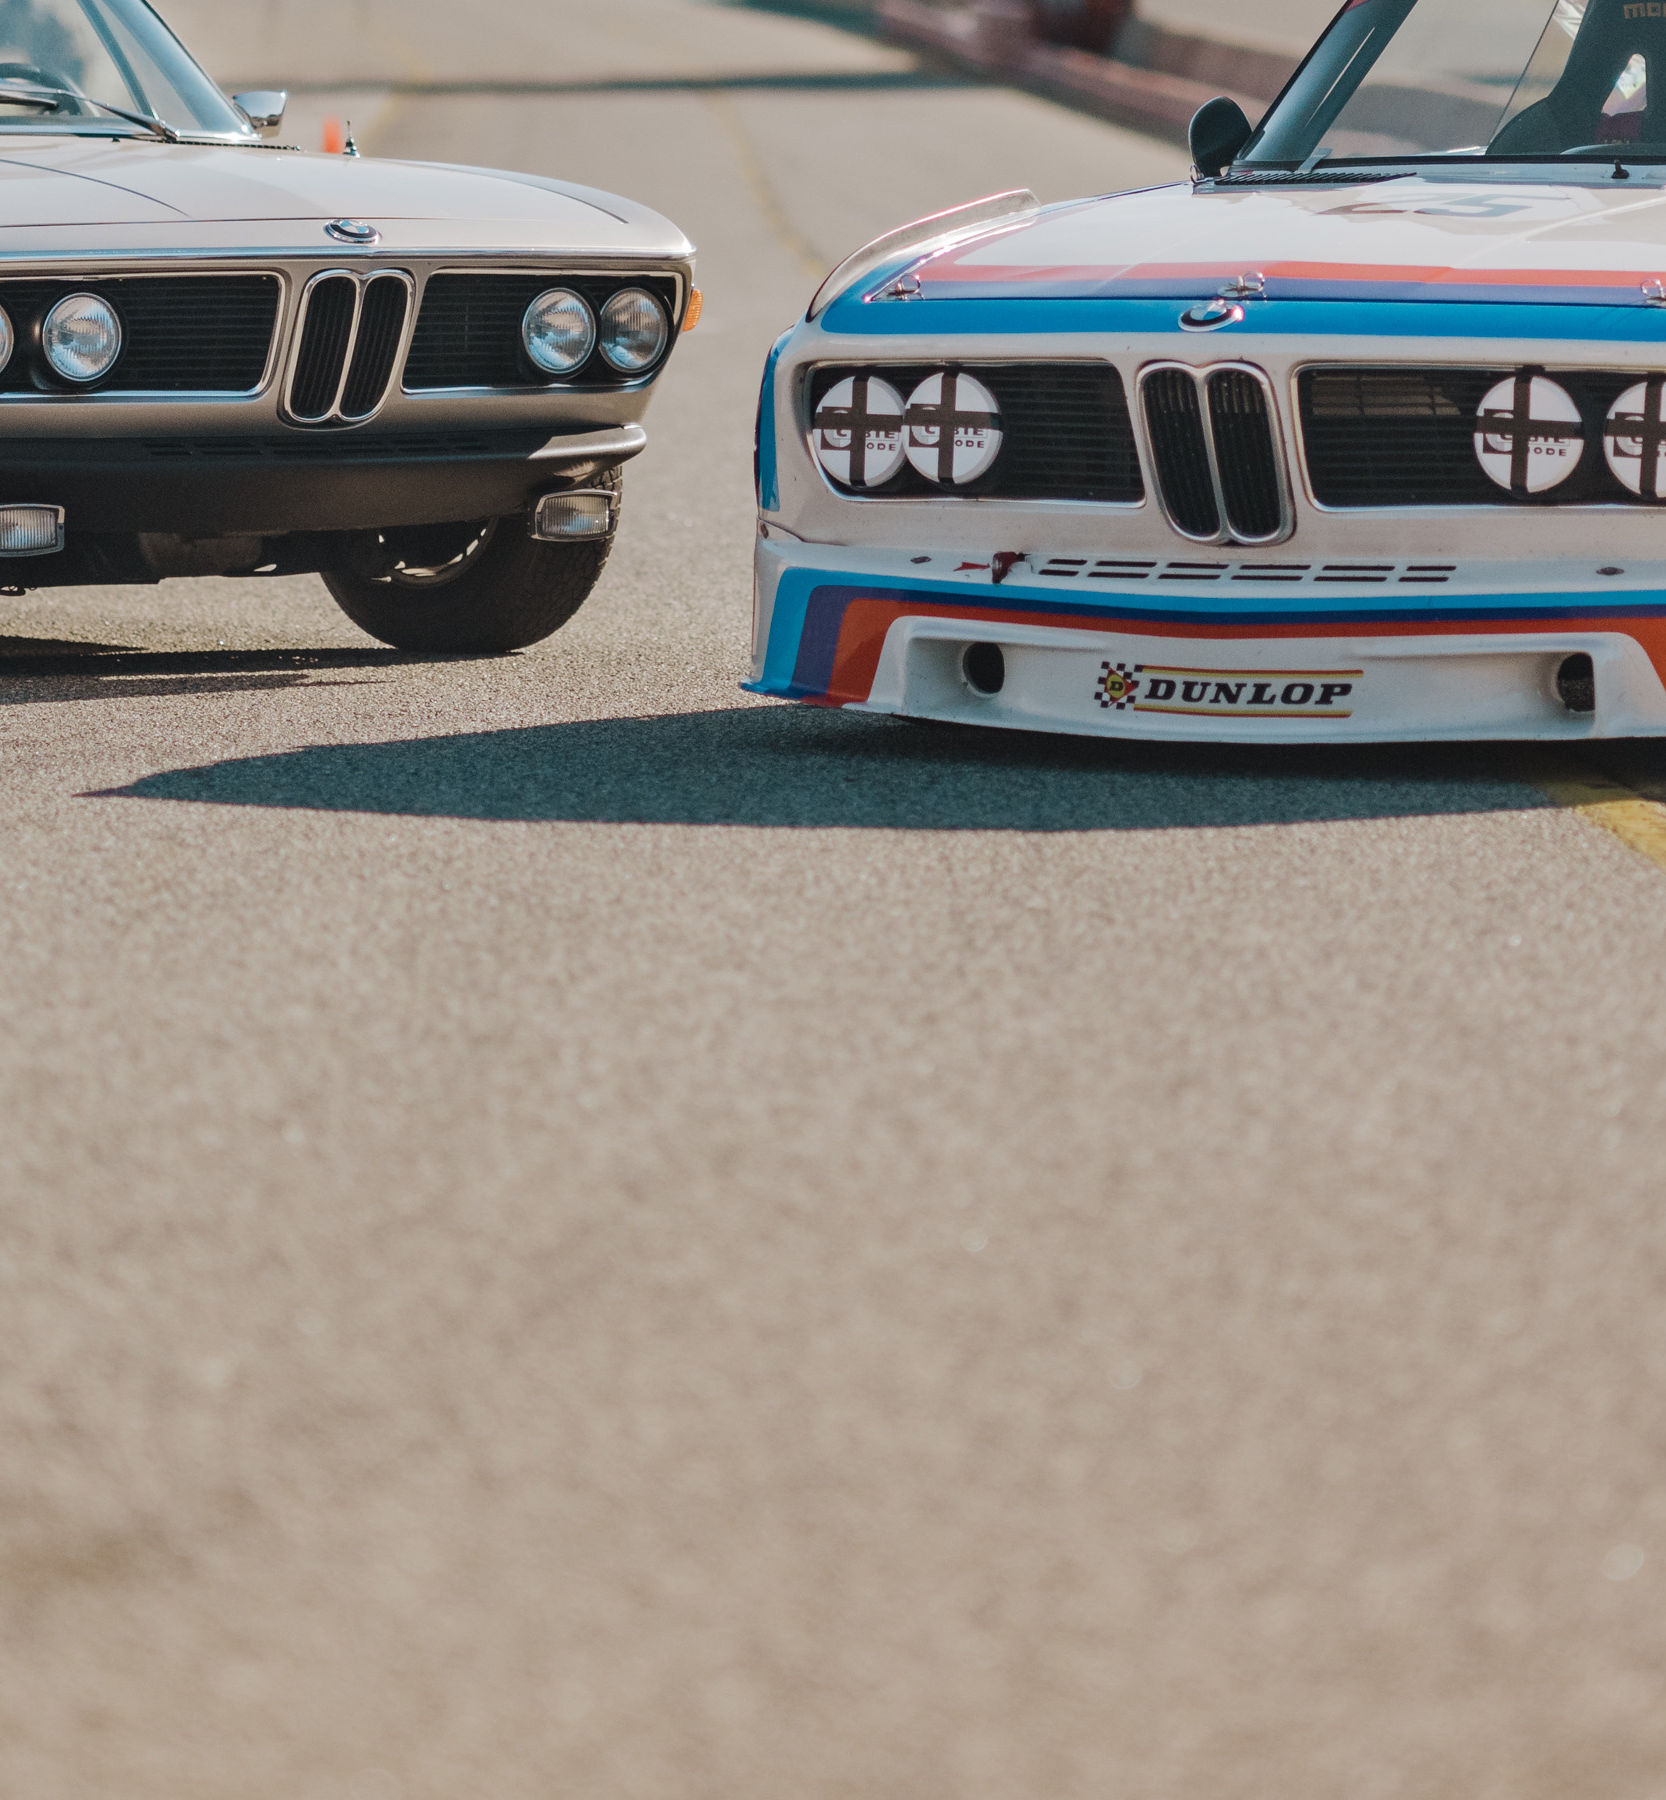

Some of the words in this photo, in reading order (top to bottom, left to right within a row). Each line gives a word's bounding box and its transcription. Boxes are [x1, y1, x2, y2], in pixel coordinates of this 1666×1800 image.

[866, 442, 897, 452] ODE
[954, 439, 985, 449] ODE
[1528, 446, 1568, 457] ODE
[1144, 677, 1353, 706] DUNLOP
